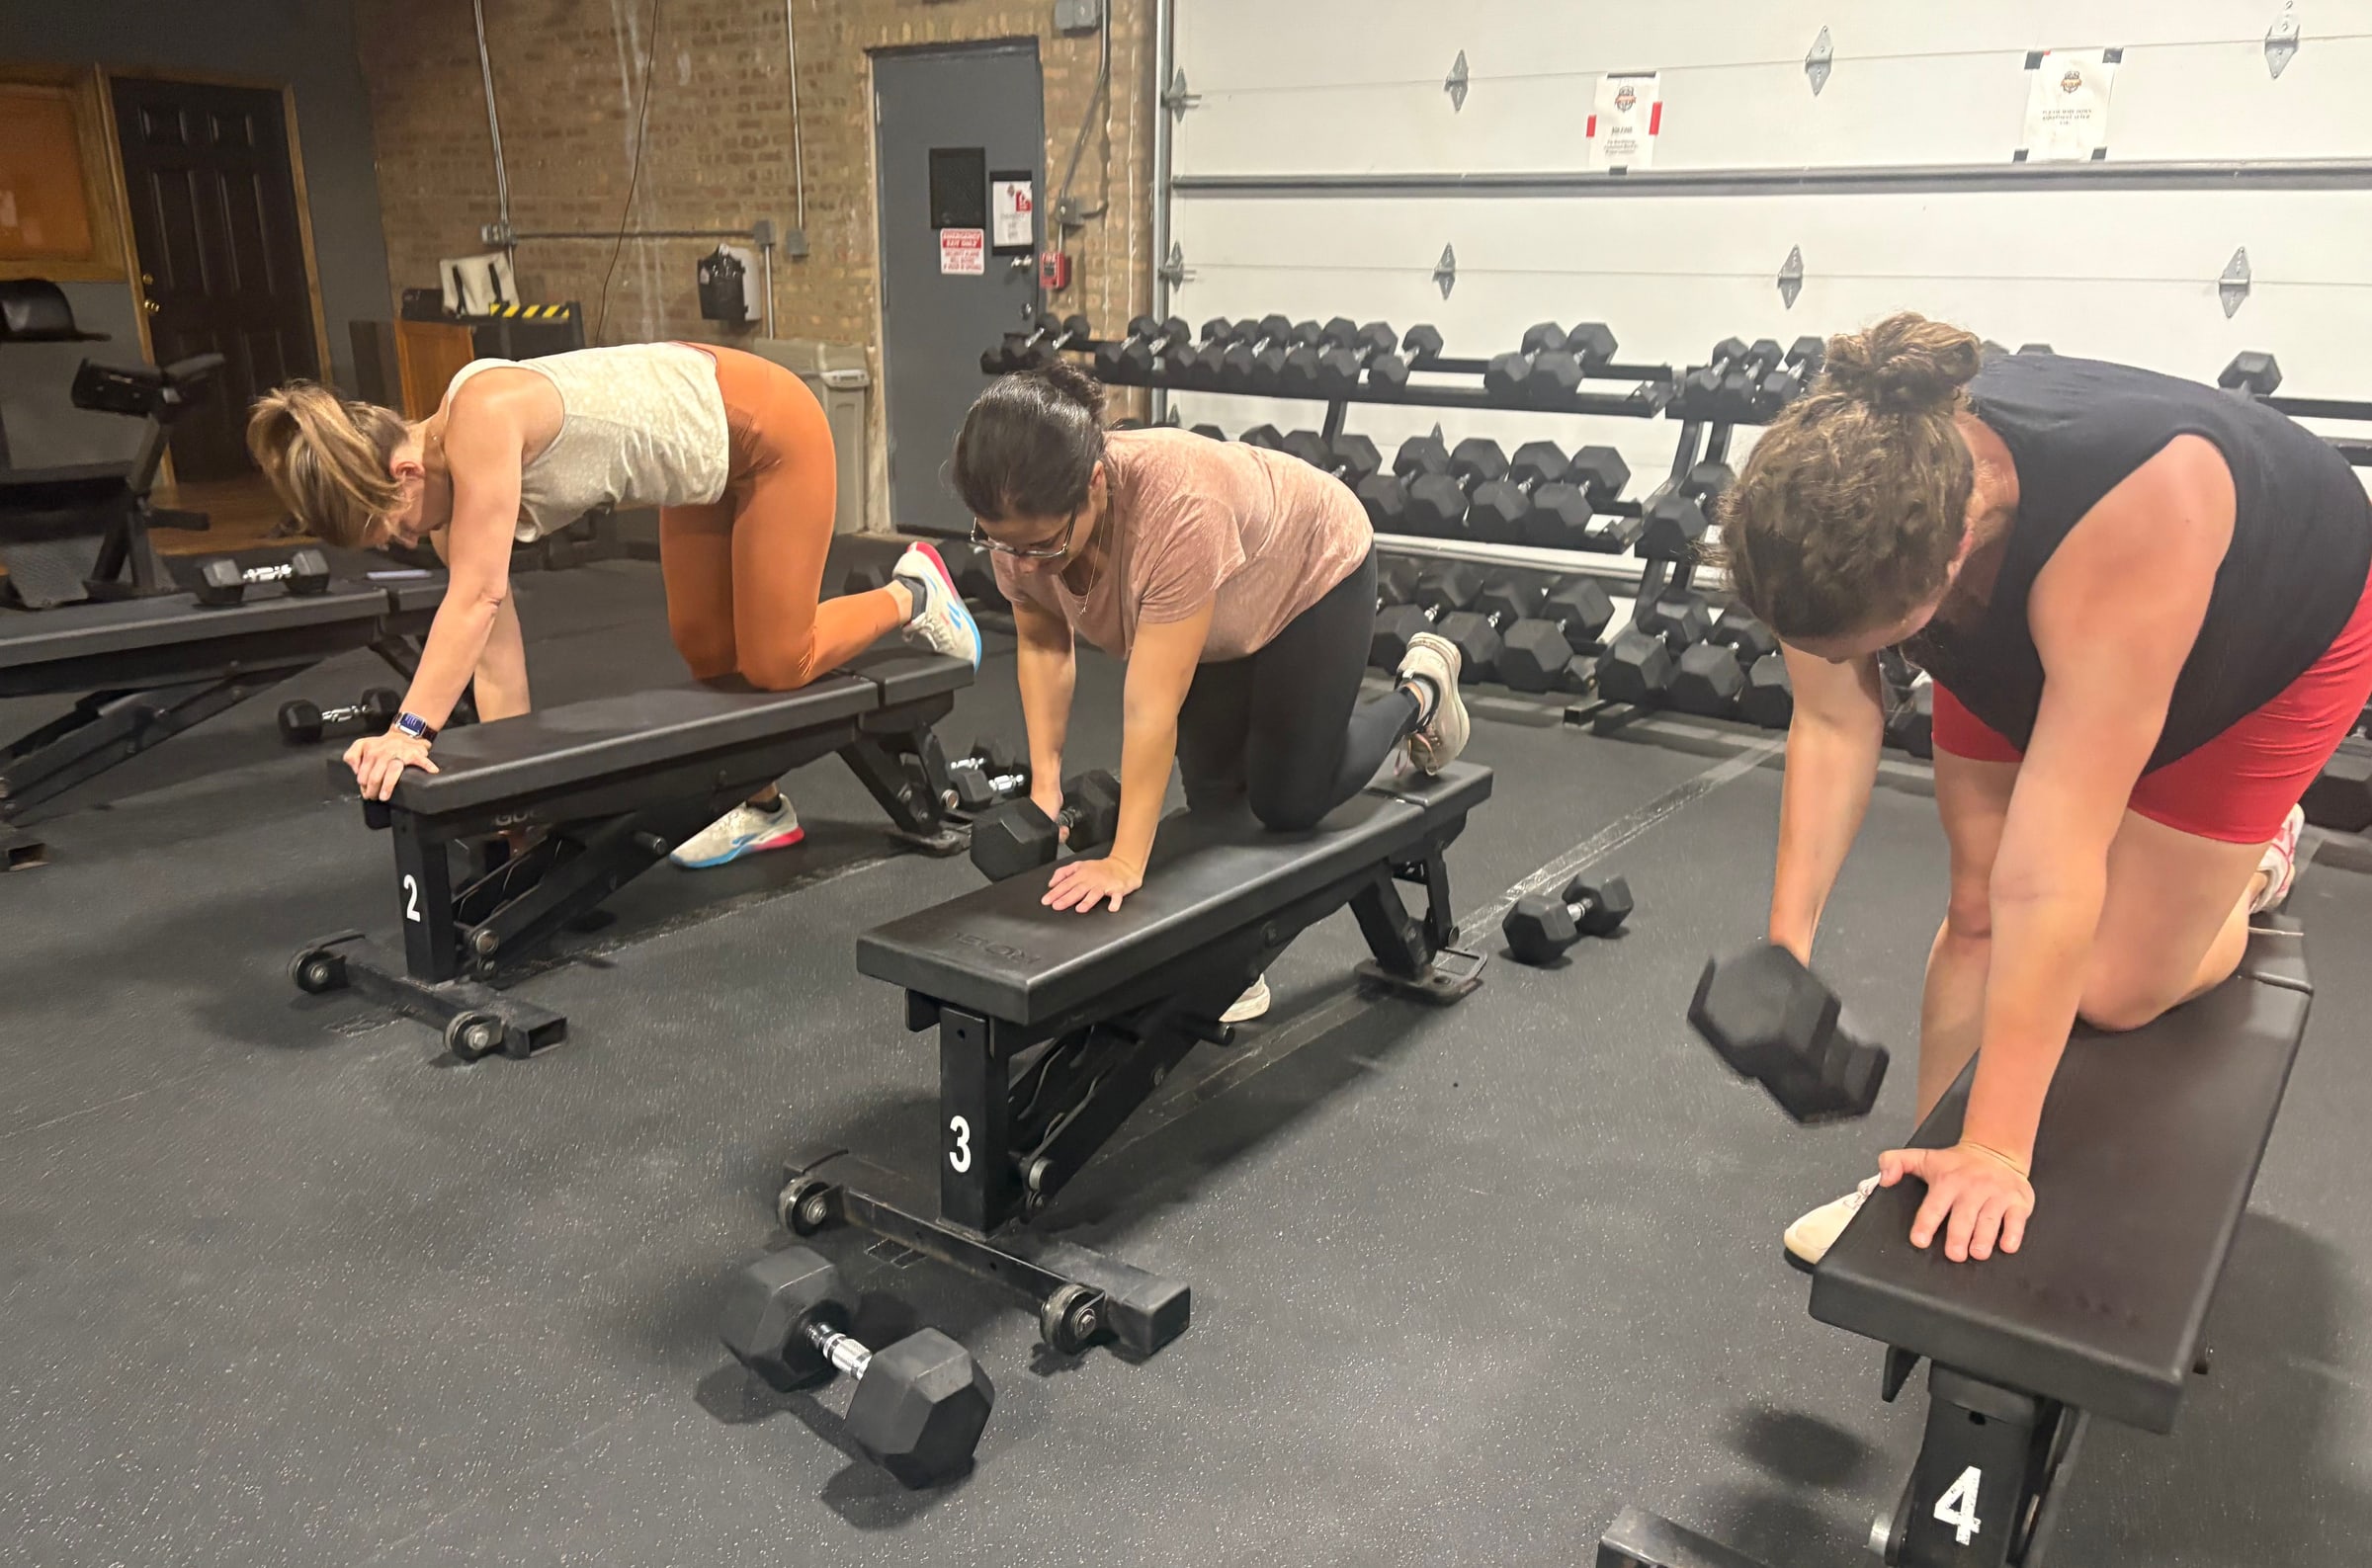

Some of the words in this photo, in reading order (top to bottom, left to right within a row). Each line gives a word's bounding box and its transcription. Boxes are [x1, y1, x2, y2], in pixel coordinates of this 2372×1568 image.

[403, 873, 421, 923] 2
[949, 1114, 972, 1173] 3
[1932, 1465, 1983, 1546] 4
